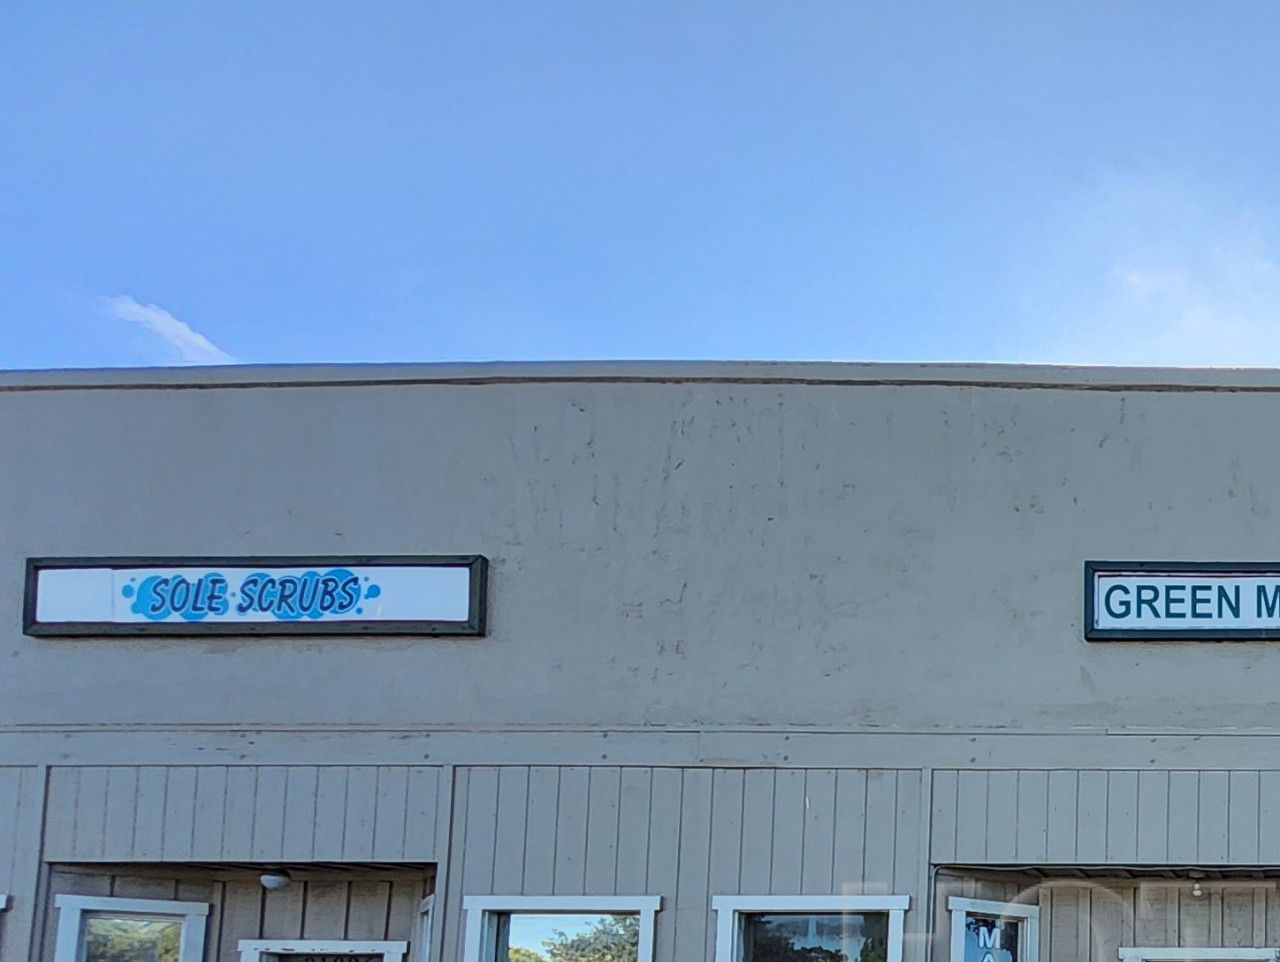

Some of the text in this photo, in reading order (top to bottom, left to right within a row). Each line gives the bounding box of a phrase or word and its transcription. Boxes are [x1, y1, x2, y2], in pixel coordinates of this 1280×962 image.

[150, 575, 360, 613] SOLE SCRUBS
[1104, 584, 1240, 619] GREEN
